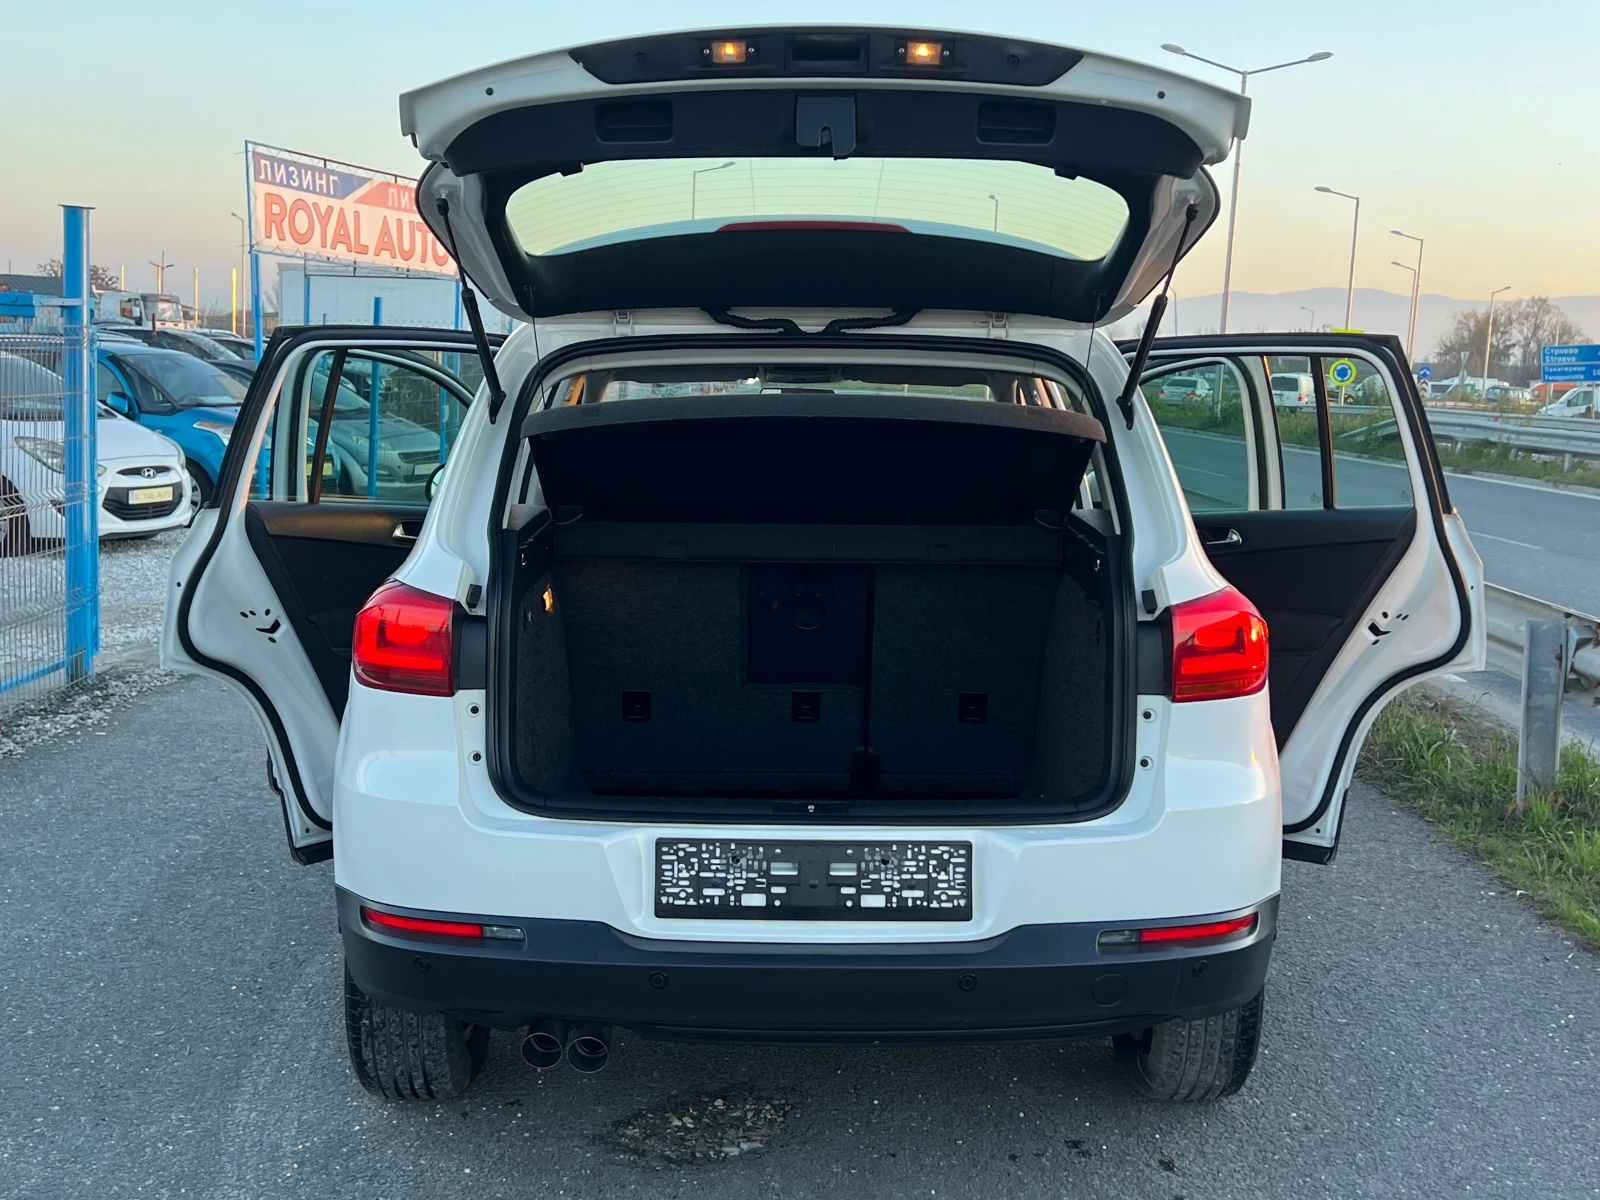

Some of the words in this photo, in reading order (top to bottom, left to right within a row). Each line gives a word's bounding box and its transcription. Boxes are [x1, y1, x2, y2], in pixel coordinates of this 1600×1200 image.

[258, 159, 338, 195] ЛИЗИНГ
[264, 192, 369, 255] ROYAL
[1544, 347, 1579, 355] Строево
